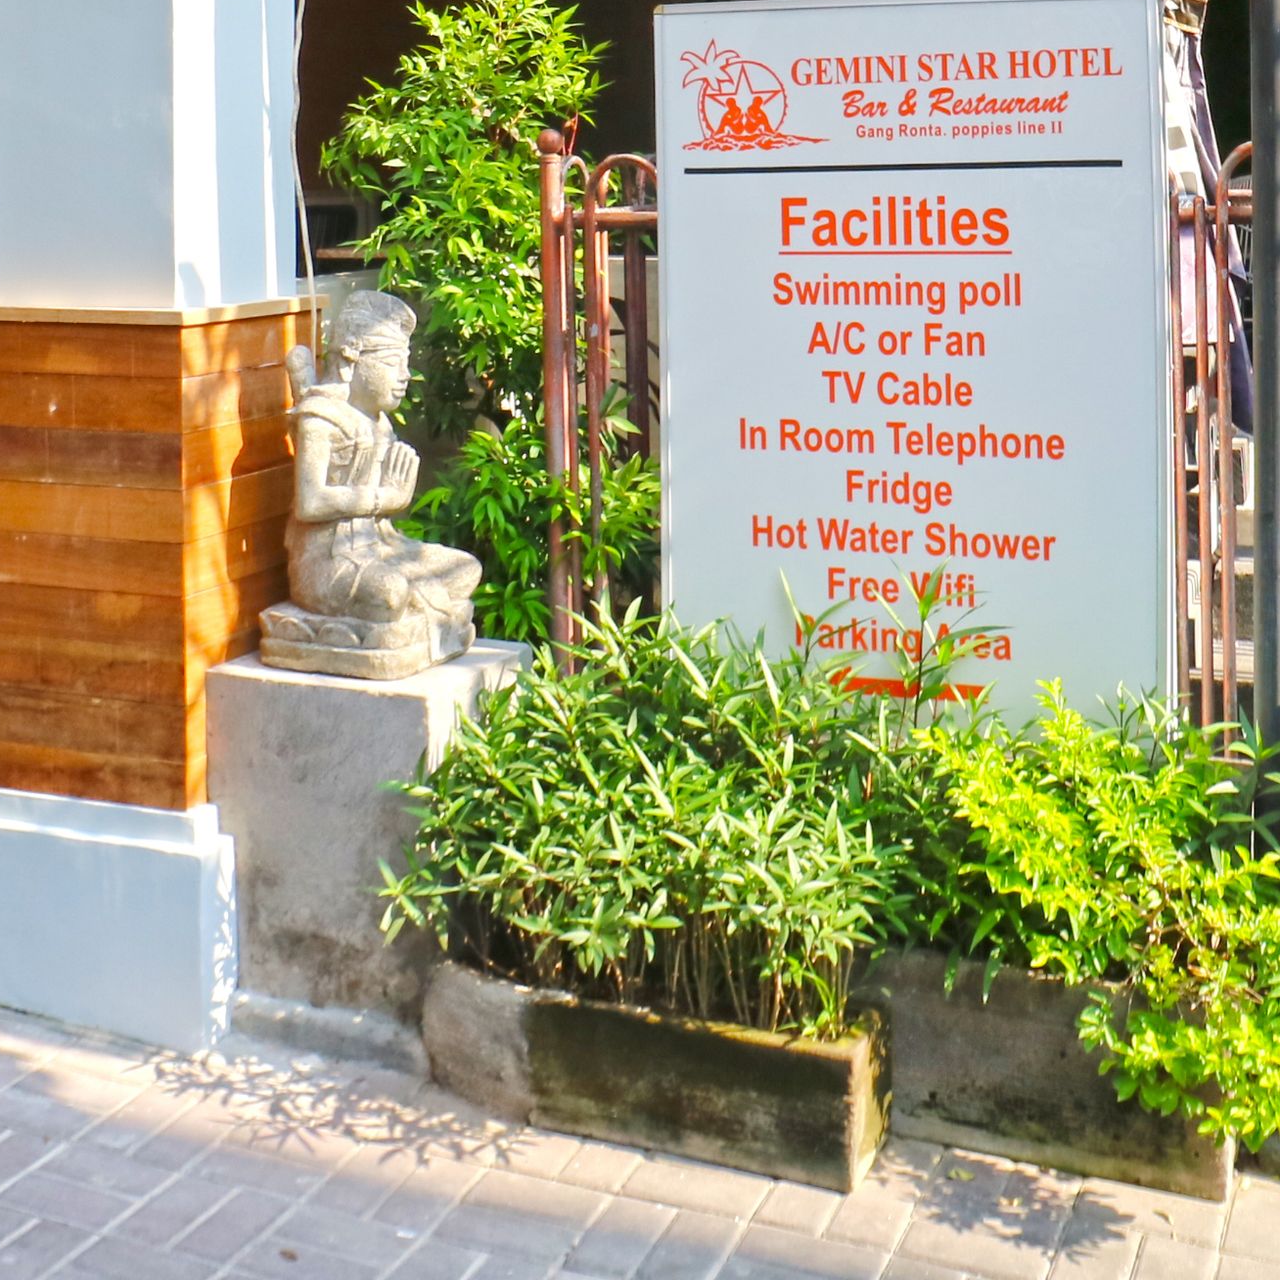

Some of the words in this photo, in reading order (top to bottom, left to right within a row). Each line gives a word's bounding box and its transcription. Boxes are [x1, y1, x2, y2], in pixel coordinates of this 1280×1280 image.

[790, 54, 909, 87] GEMINI
[917, 51, 999, 82] STAR
[1008, 47, 1124, 80] HOTEL
[841, 88, 889, 119] Bar
[898, 87, 919, 116] &
[928, 86, 1070, 116] Restaurant
[856, 124, 894, 141] Gang
[898, 123, 947, 138] Ronta.
[951, 122, 1014, 138] poppies
[1017, 121, 1046, 135] line
[780, 194, 1011, 247] Facilities
[773, 271, 947, 316] Swimming
[958, 272, 1023, 315] poll
[807, 320, 867, 357] A/C
[877, 330, 914, 357] or
[924, 321, 987, 358] Fan
[821, 369, 867, 405] TV
[876, 370, 975, 408] Cable
[738, 416, 769, 451] In
[779, 417, 877, 455] Room
[886, 420, 1067, 466] Telephone
[845, 468, 955, 514] Fridge
[751, 513, 809, 550] Hot
[817, 516, 915, 556] Water
[924, 521, 1058, 562] Shower
[826, 566, 901, 604] Free
[909, 570, 977, 609] Wifi
